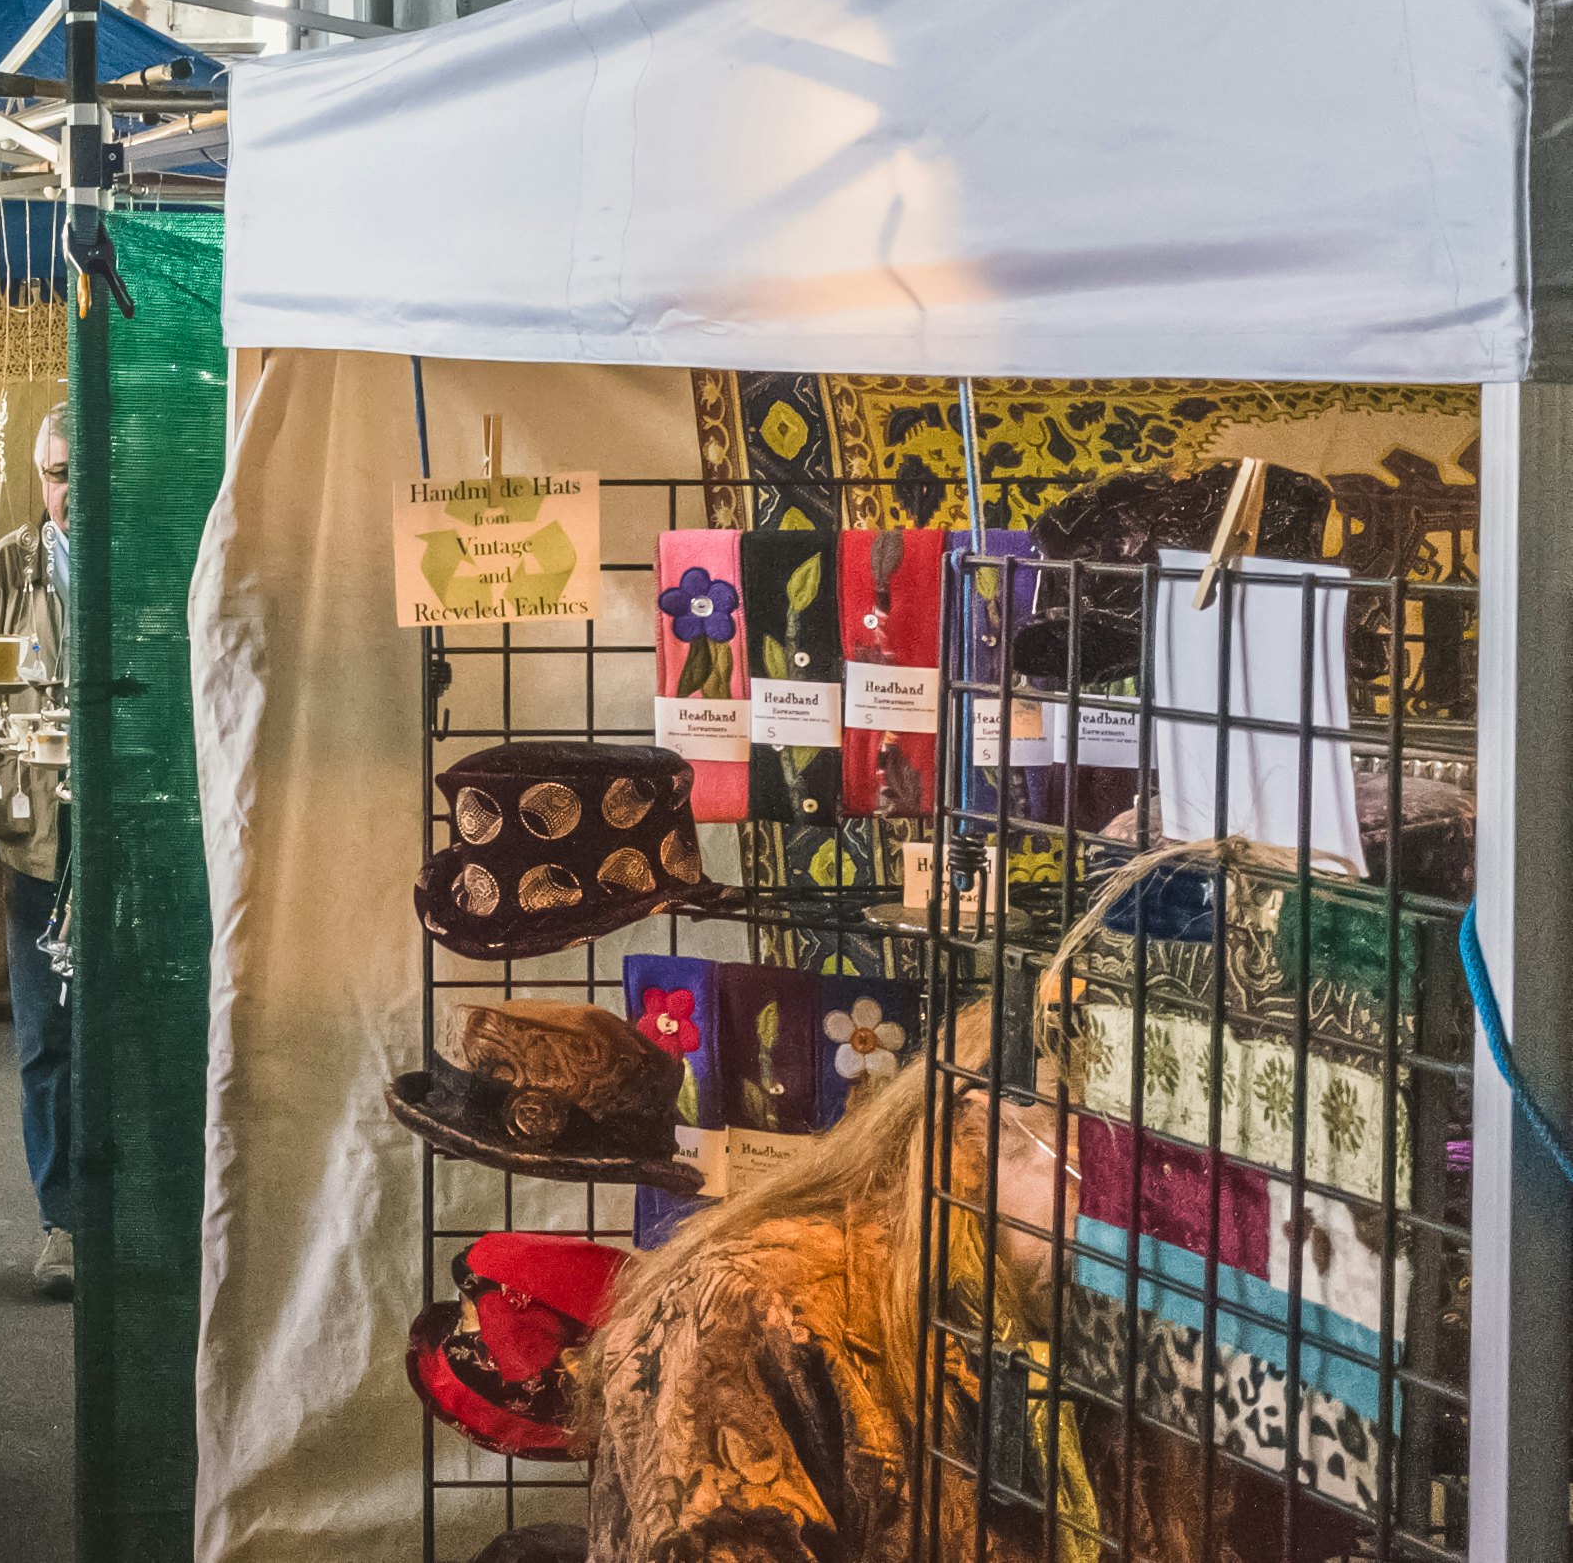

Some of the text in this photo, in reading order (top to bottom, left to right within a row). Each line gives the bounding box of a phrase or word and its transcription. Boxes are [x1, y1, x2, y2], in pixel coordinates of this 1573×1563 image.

[410, 476, 581, 503] Handmde Hats
[473, 512, 510, 526] from
[456, 537, 533, 558] Vintage
[479, 566, 512, 583] and
[414, 595, 589, 622] Recycled Fabrics
[864, 681, 924, 696] Headband
[764, 691, 819, 706] Headband
[678, 709, 736, 723] Headband
[864, 713, 873, 724] S
[767, 726, 777, 739] S
